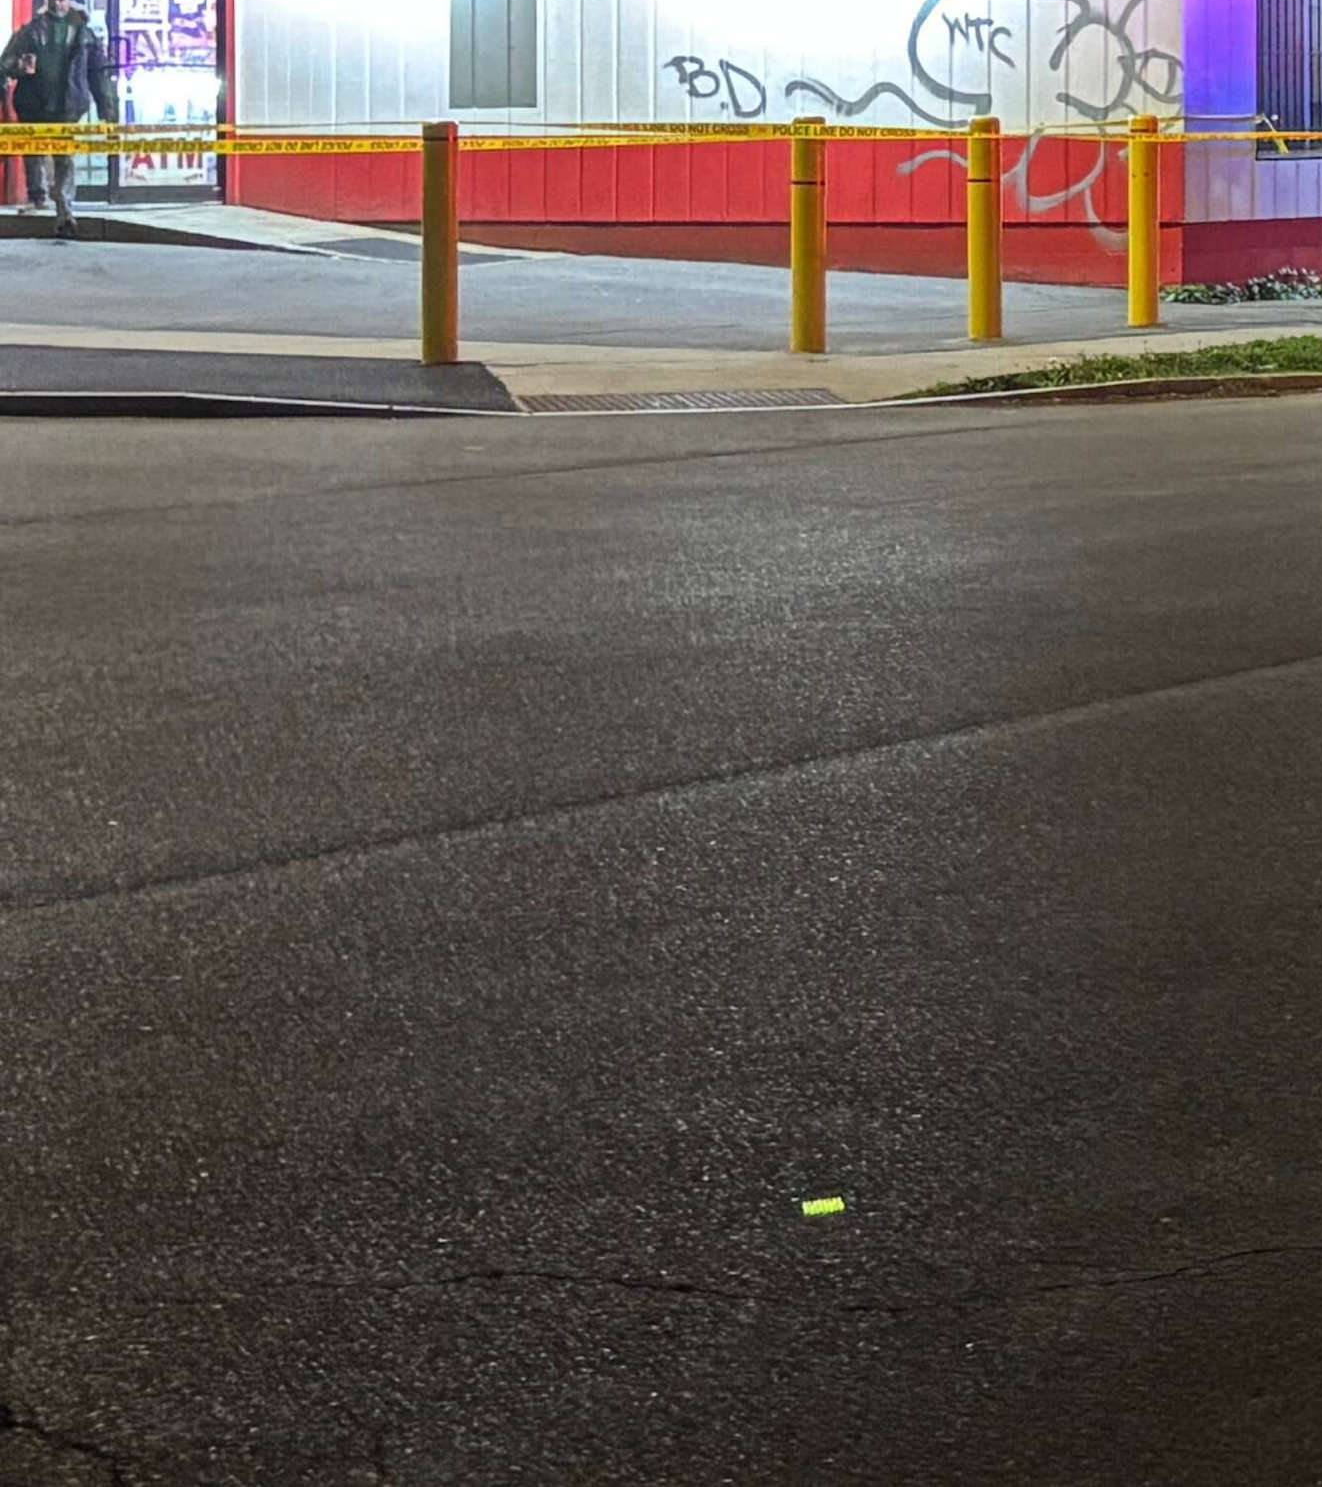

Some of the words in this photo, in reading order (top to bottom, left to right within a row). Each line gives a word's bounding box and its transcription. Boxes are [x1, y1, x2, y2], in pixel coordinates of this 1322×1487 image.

[670, 123, 686, 133] DO
[688, 124, 710, 134] NOT
[772, 125, 810, 137] POLICE
[813, 126, 838, 137] LINE
[839, 126, 855, 137] DO
[857, 127, 878, 137] NOT
